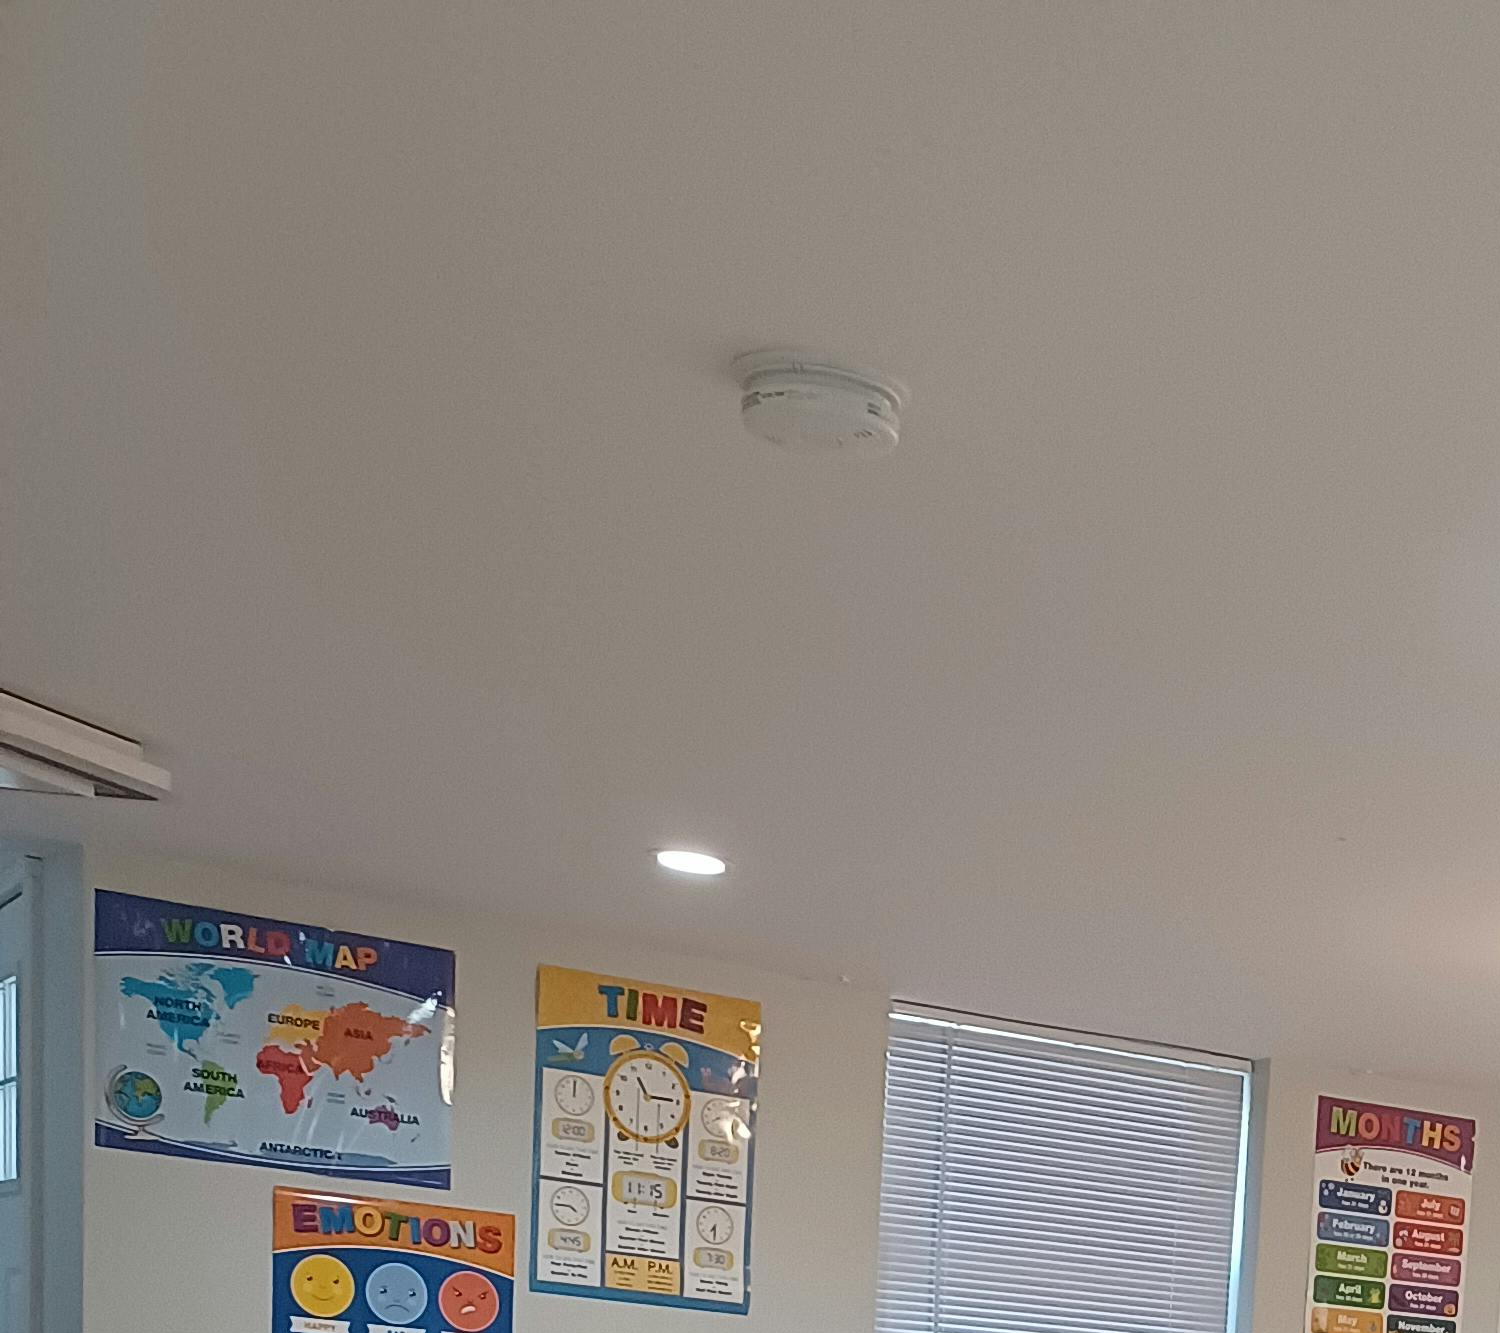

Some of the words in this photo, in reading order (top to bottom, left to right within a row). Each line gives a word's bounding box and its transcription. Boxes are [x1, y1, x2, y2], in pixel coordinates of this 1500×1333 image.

[161, 918, 291, 957] WORLD
[303, 938, 377, 971] MAP
[155, 996, 201, 1011] NORTH
[598, 984, 708, 1034] TIME
[146, 1009, 210, 1027] AMERICA
[267, 1013, 320, 1030] EUROPE
[344, 1027, 373, 1041] ASIA
[192, 1068, 237, 1084] SOUTH
[184, 1082, 245, 1098] AMERICA
[350, 1107, 419, 1125] AUSTRALIA
[1330, 1106, 1462, 1152] MONTHS
[1364, 1162, 1387, 1173] There
[627, 1181, 663, 1199] 11:15
[1336, 1188, 1376, 1202] January
[1421, 1199, 1440, 1211] July
[291, 1204, 502, 1254] EMOTIONS
[1332, 1219, 1376, 1234] February
[1412, 1230, 1445, 1242] August
[1336, 1251, 1367, 1264] March
[611, 1258, 638, 1271] A.M.
[648, 1261, 673, 1275] P.M.
[1402, 1259, 1451, 1273] September
[1339, 1282, 1362, 1296] April
[1405, 1290, 1442, 1304] October
[1398, 1321, 1446, 1333] November
